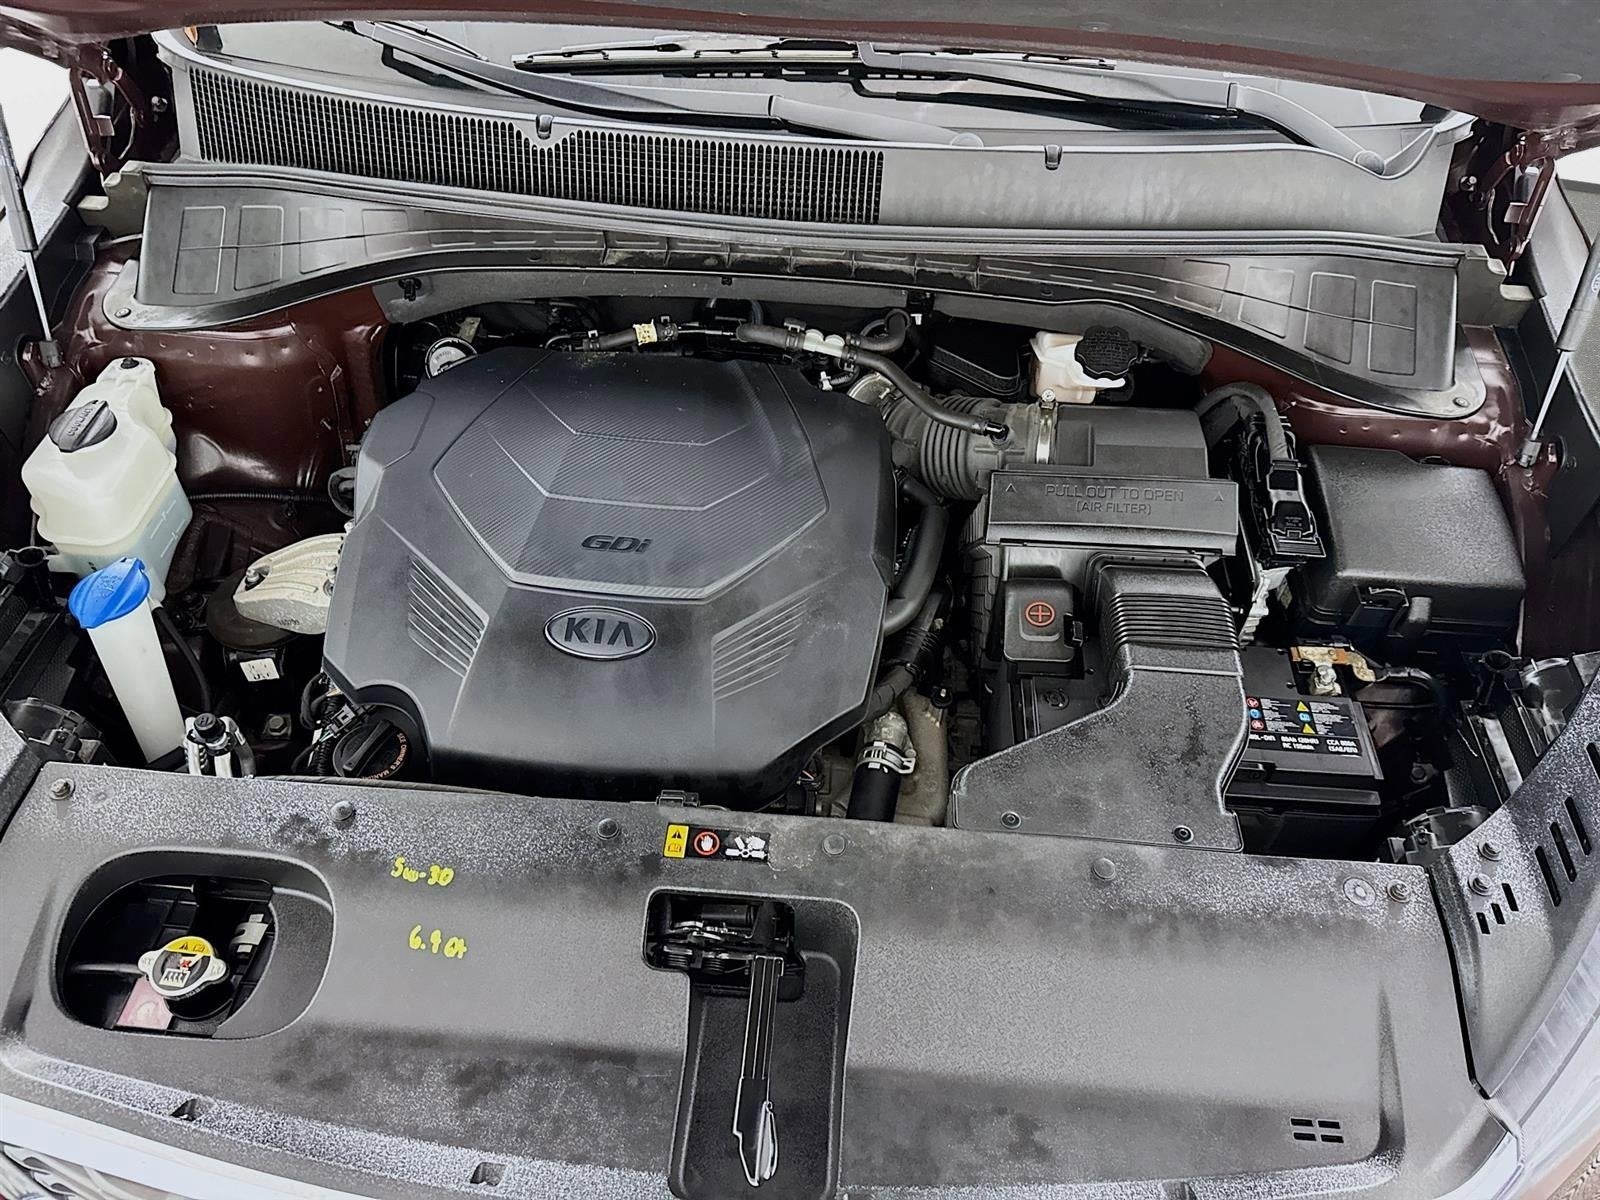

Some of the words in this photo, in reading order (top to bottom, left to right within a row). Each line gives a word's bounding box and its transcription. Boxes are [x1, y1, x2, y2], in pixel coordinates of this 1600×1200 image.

[1044, 483, 1083, 498] PULL
[1086, 485, 1117, 499] OUT
[1120, 486, 1140, 500] TO
[1143, 487, 1185, 502] OPEN
[1076, 500, 1102, 513] (AIR
[1105, 502, 1152, 515] FILTER)
[564, 617, 634, 647] KIA
